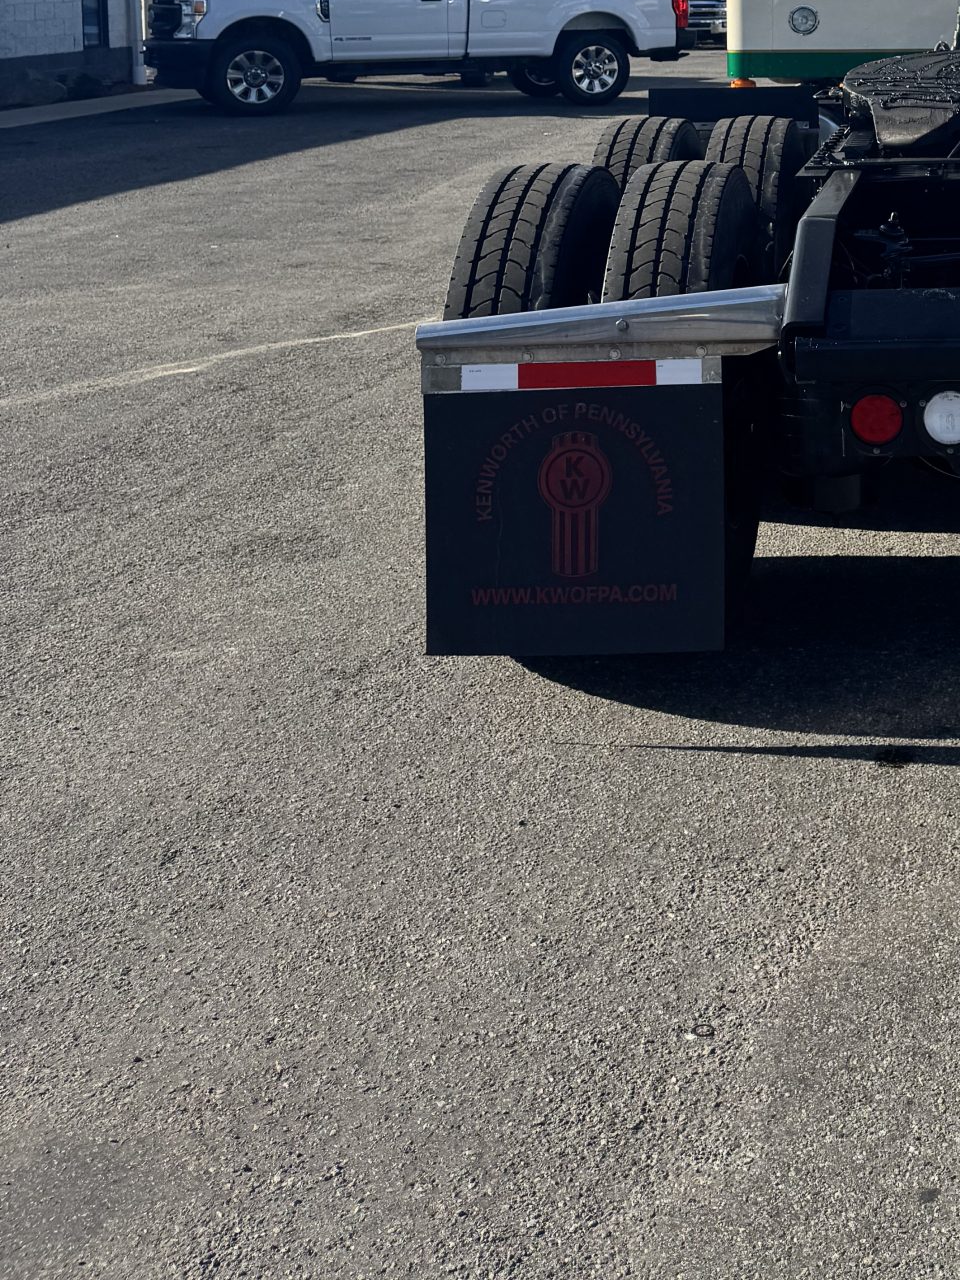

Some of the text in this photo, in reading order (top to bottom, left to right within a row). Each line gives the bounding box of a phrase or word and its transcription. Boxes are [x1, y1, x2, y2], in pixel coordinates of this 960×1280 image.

[476, 402, 673, 521] KENWORTH OF PENNSYLVANIA
[565, 455, 584, 478] K
[559, 478, 590, 500] W
[472, 584, 677, 606] WWW.KWOFPA.COM
